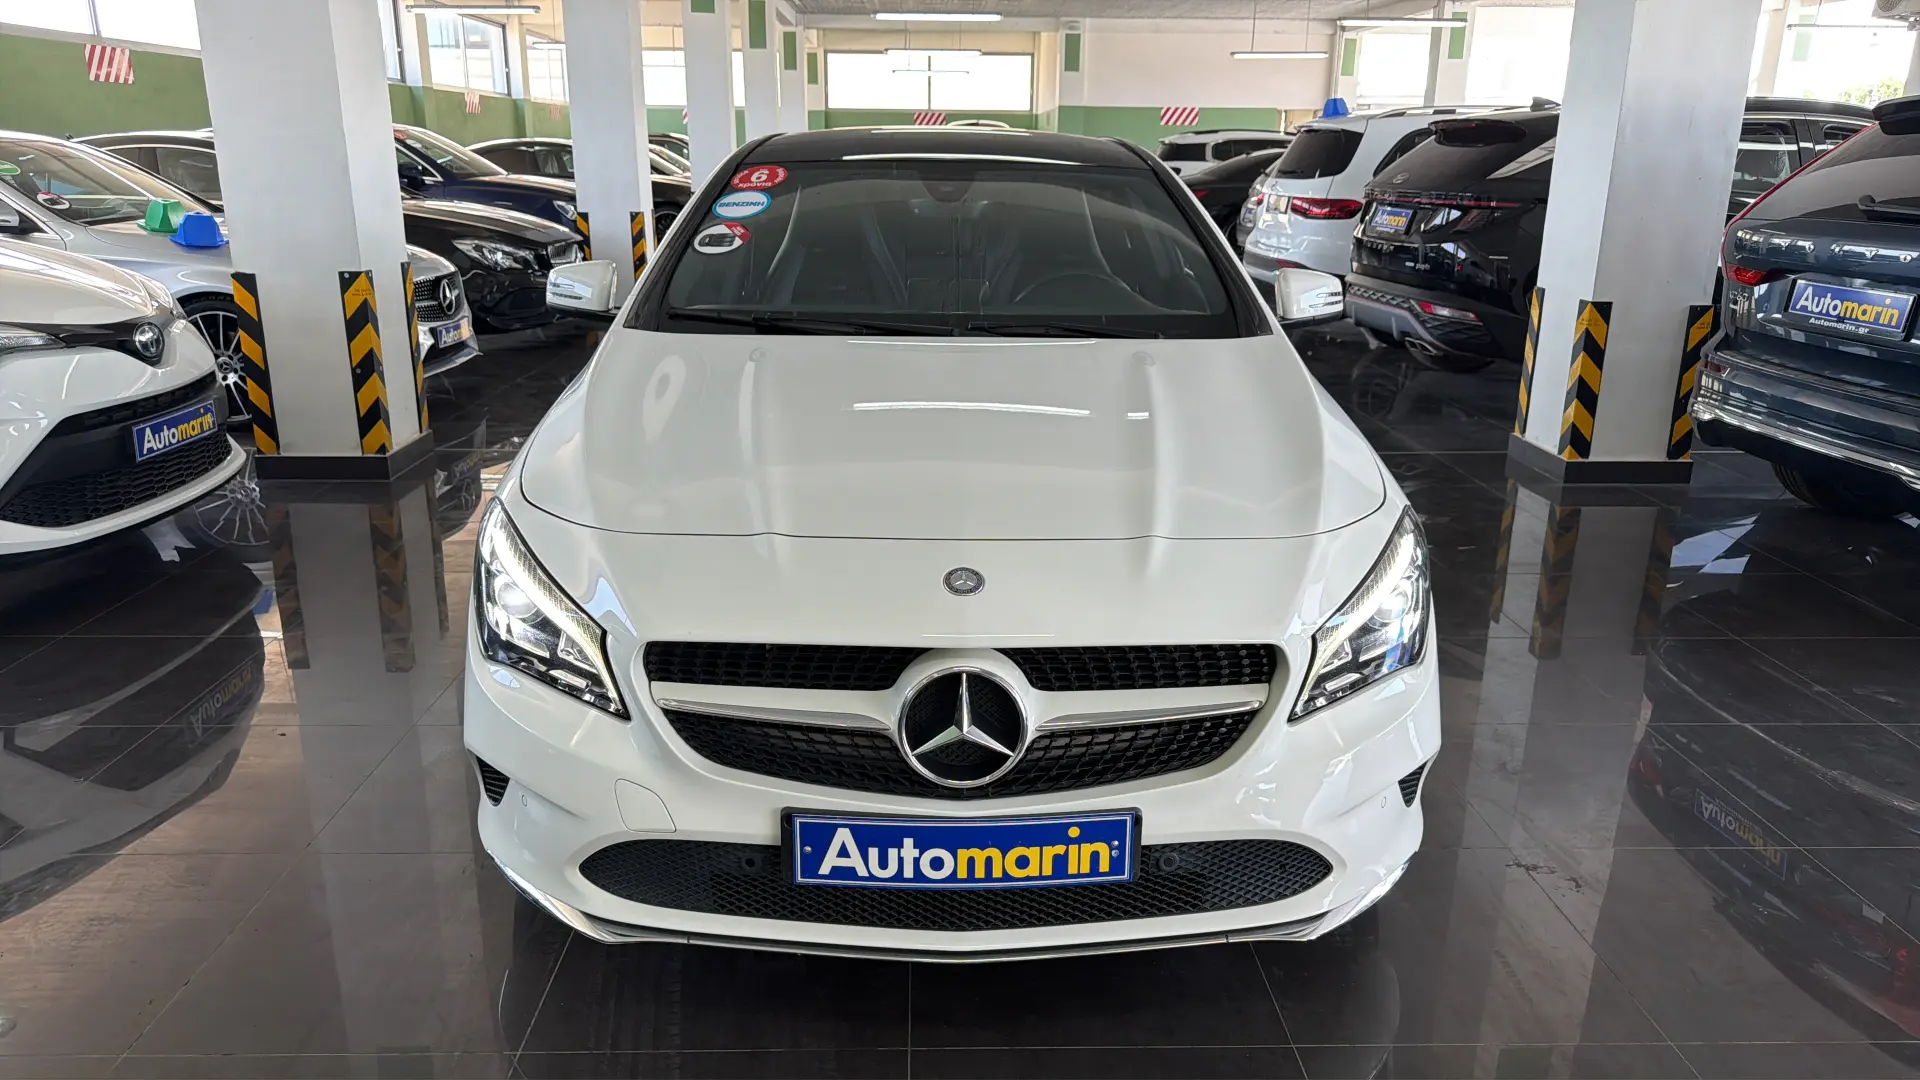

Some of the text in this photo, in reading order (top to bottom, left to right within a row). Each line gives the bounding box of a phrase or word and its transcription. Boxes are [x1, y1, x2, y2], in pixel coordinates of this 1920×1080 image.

[750, 170, 770, 182] 6
[1796, 286, 1900, 326] Automarin
[1808, 317, 1870, 334] Automarin.gr
[143, 407, 213, 454] Automarin
[818, 826, 1110, 879] Automarin
